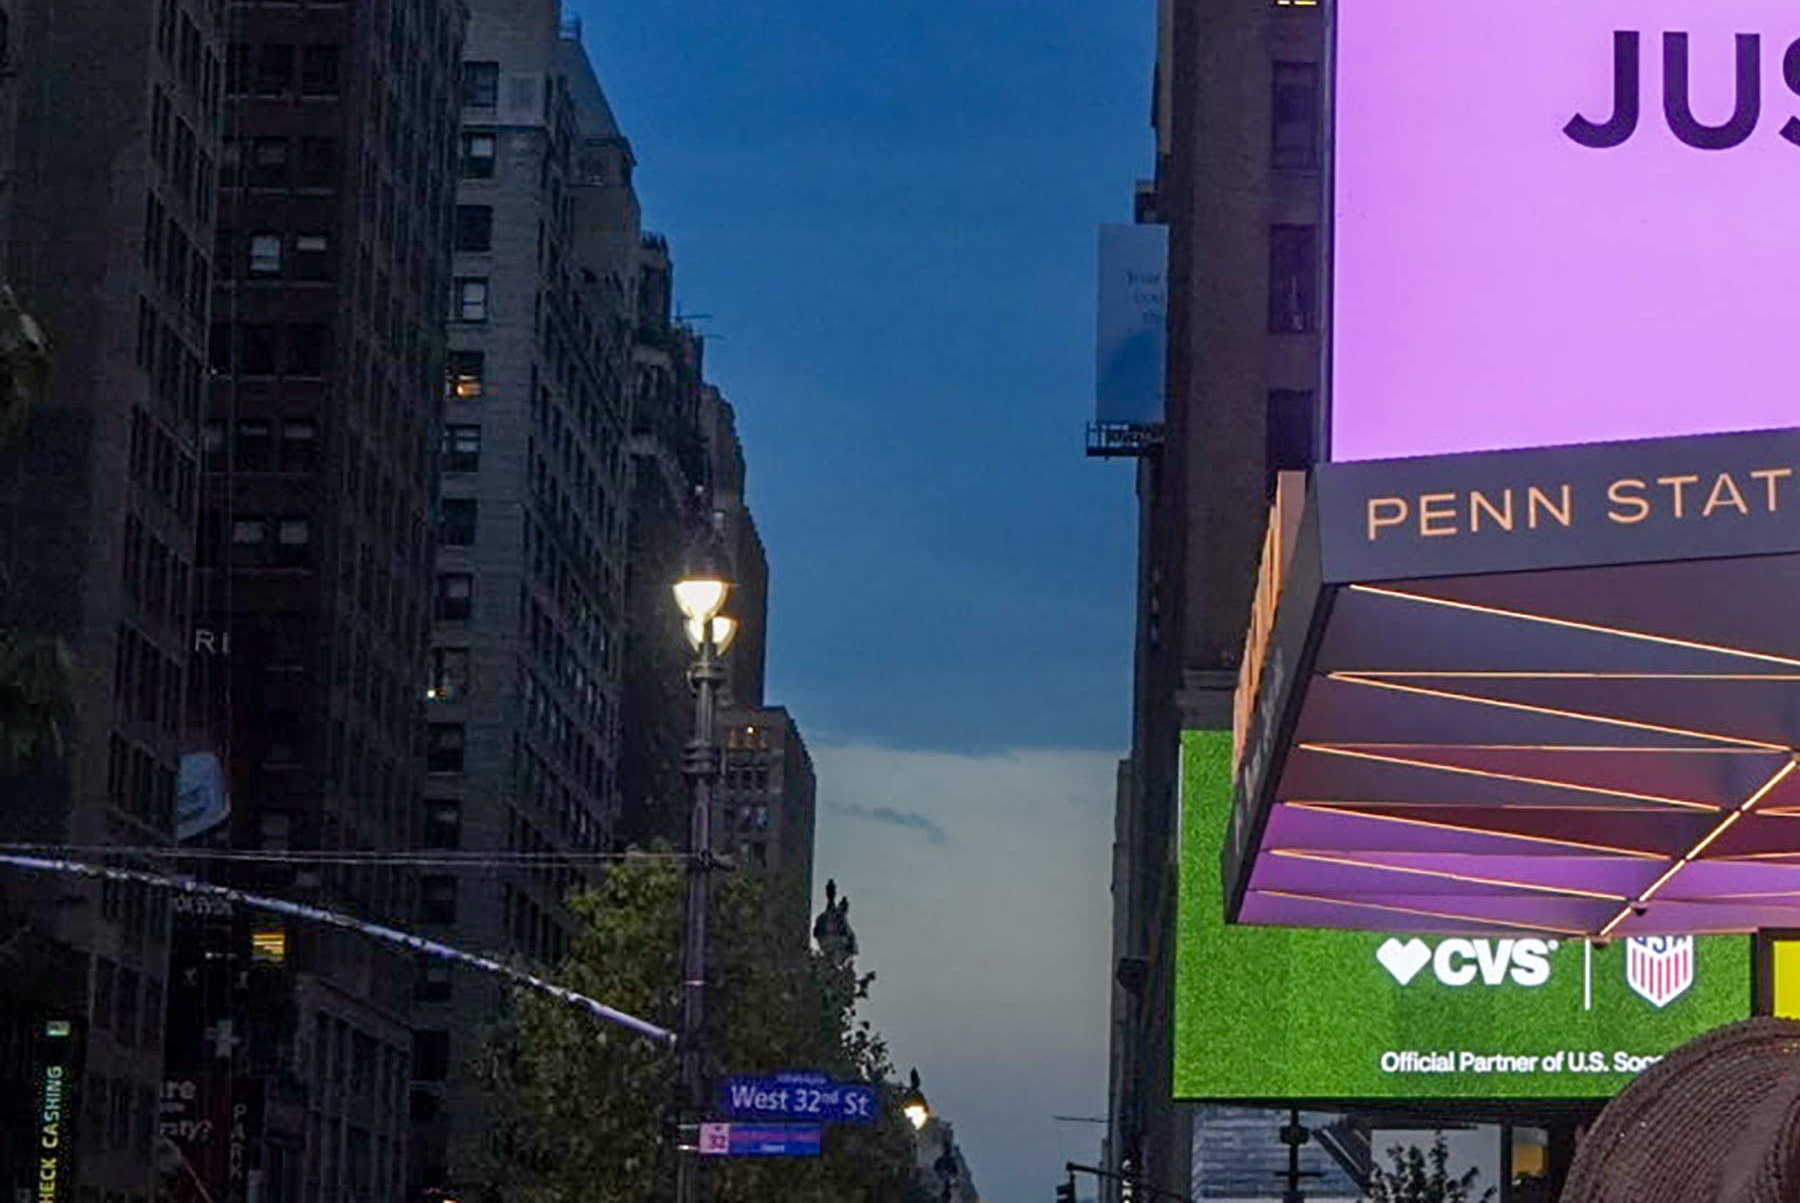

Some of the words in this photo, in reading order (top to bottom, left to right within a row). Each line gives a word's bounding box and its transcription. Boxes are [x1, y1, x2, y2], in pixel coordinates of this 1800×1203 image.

[1368, 484, 1571, 540] PENN
[1380, 1051, 1456, 1073] Official
[1459, 1051, 1539, 1073] Partner
[1541, 1051, 1565, 1073] of
[1567, 1051, 1610, 1073] U.S.
[1613, 1050, 1664, 1073] Soc
[41, 1064, 64, 1149] CASHING
[731, 1084, 788, 1111] West
[793, 1087, 839, 1114] 32nd
[843, 1091, 871, 1117] St
[37, 1156, 58, 1203] HECK
